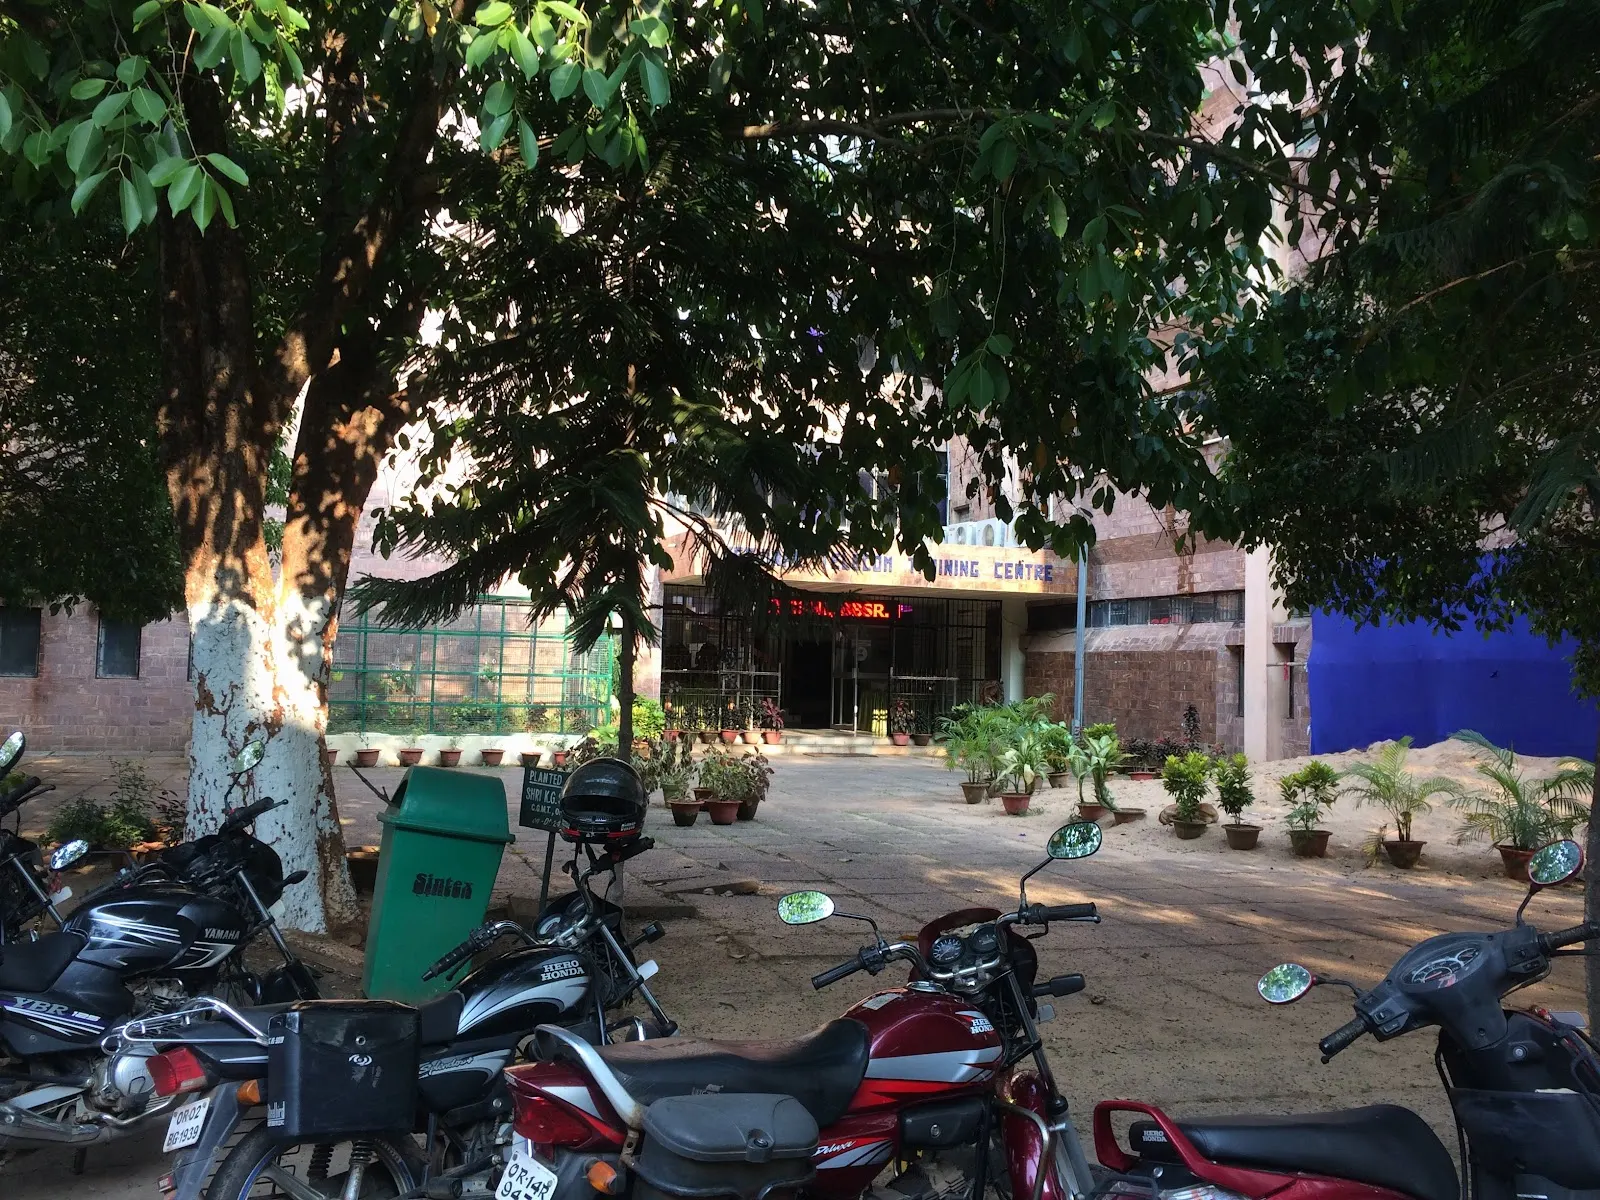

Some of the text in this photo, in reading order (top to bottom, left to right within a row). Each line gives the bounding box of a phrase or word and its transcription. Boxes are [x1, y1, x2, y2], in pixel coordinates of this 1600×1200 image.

[908, 557, 979, 578] TINING
[994, 561, 1053, 582] CENTRE
[529, 769, 563, 786] PLANTED
[526, 787, 542, 802] SHRI
[412, 873, 473, 900] Sintex
[204, 928, 240, 940] YAMAHA
[540, 967, 585, 981] HONDA
[543, 960, 580, 973] HERO
[13, 996, 68, 1016] YBR
[811, 1140, 856, 1157] Deluxe
